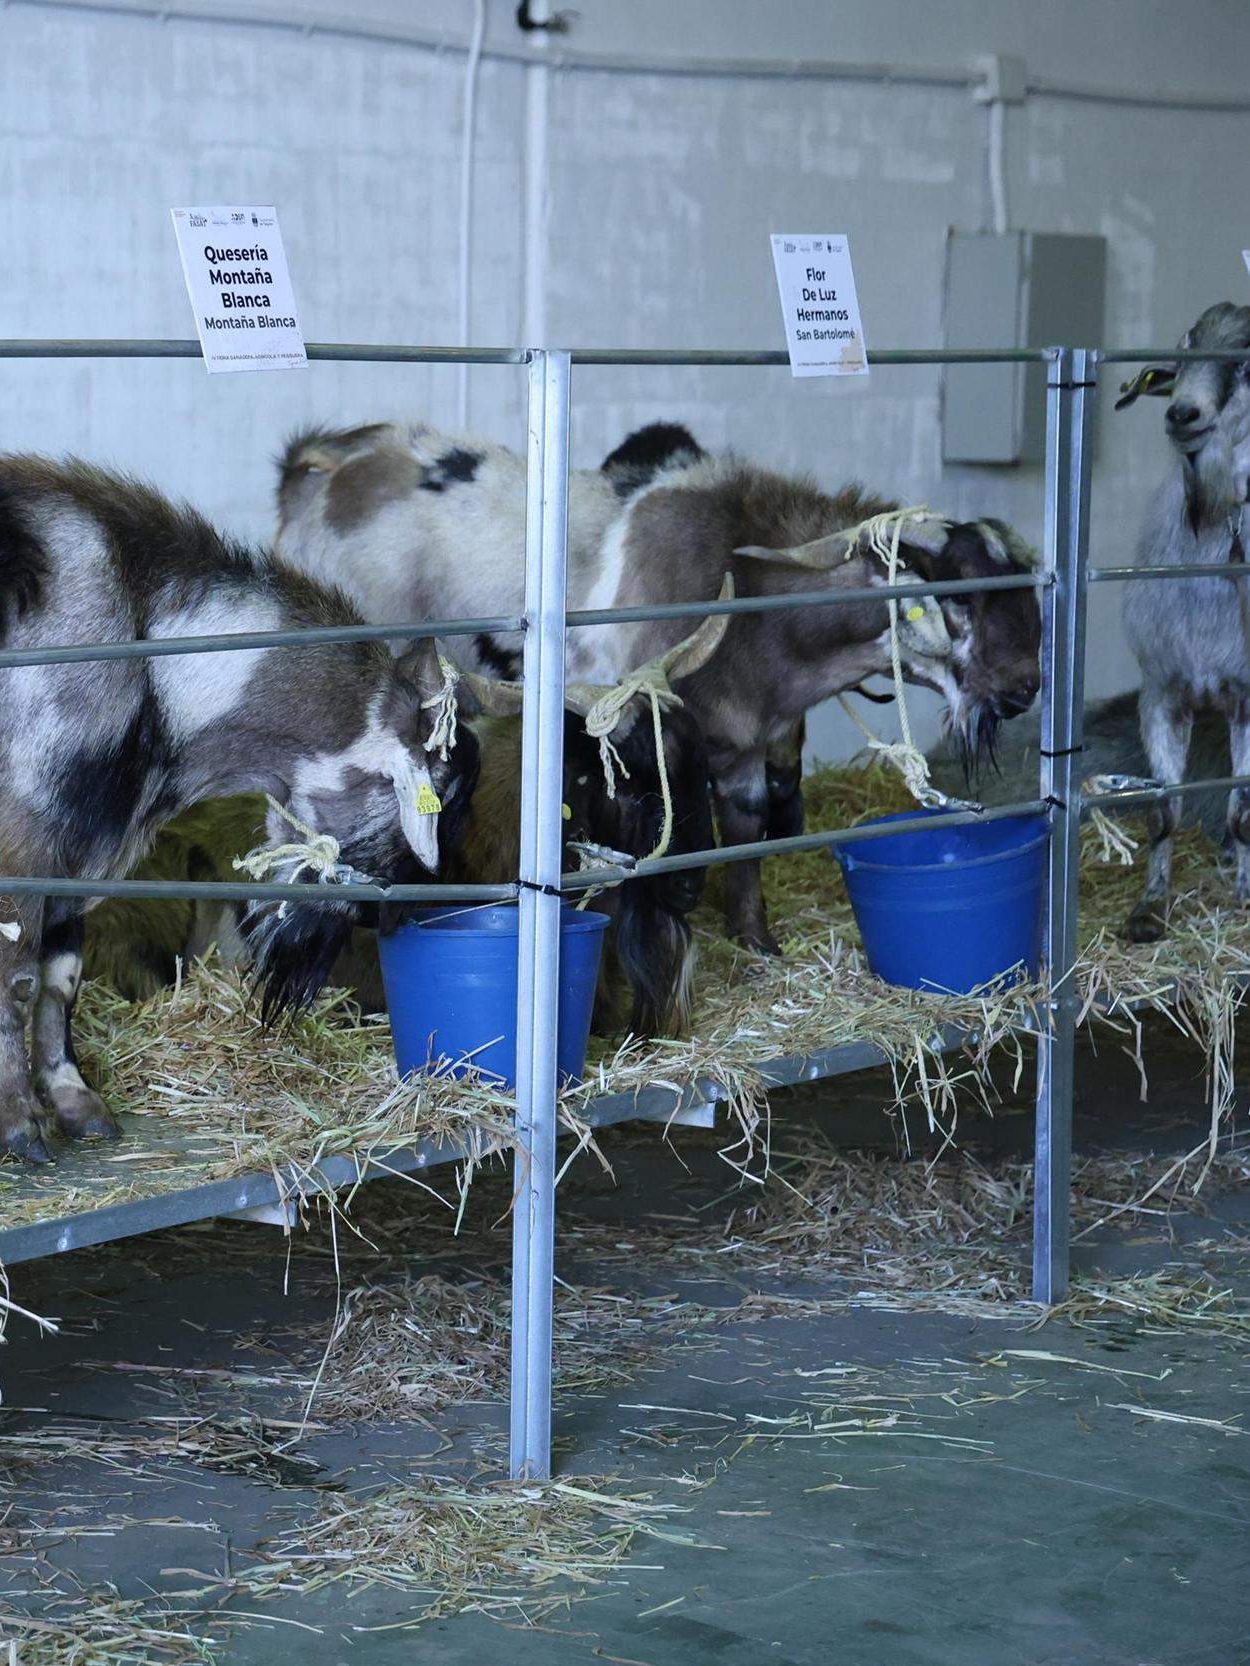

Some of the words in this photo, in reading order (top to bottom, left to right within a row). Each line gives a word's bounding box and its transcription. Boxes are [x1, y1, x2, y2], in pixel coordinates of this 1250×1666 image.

[204, 244, 268, 265] Quesería
[209, 268, 273, 285] Montaña
[806, 268, 827, 281] Flor
[221, 292, 271, 308] Blanca
[802, 288, 817, 301] De
[818, 288, 838, 301] Luz
[796, 308, 849, 321] Hermanos
[204, 315, 256, 330] Montaña
[257, 315, 296, 328] Blanca
[796, 330, 812, 341] San
[813, 328, 855, 340] Bartolomé
